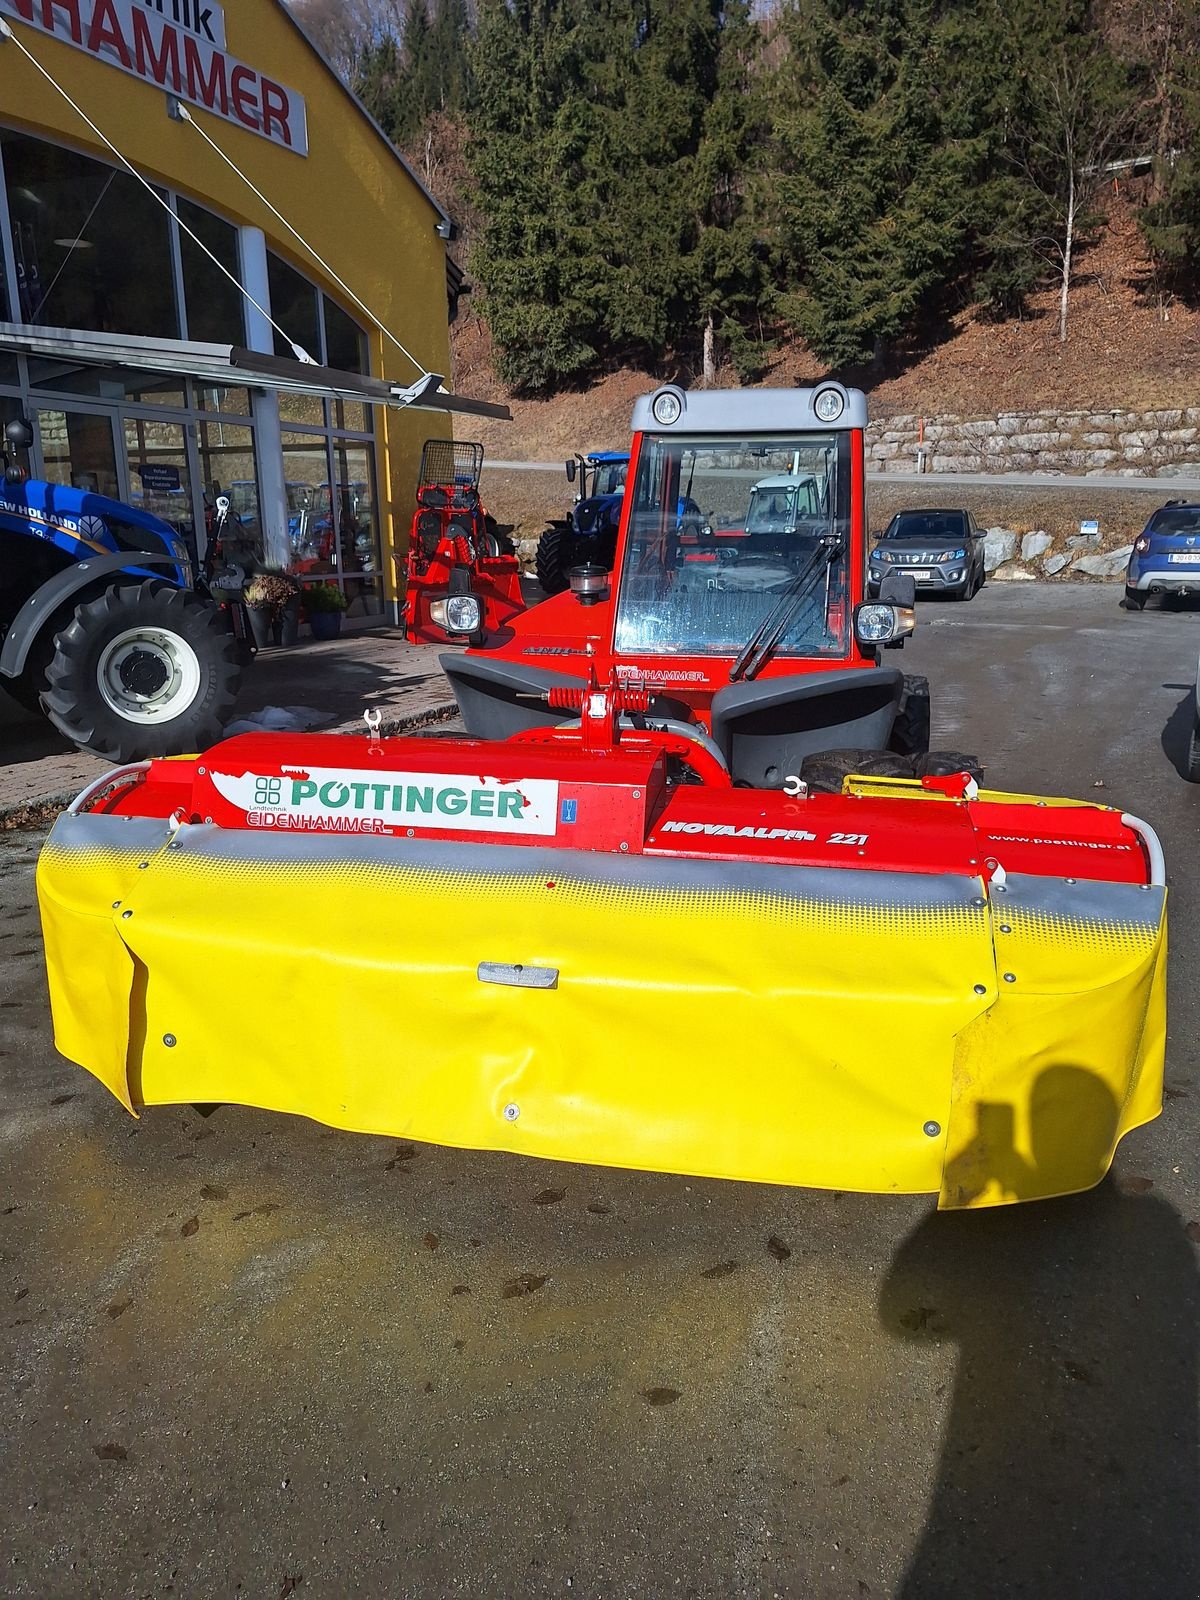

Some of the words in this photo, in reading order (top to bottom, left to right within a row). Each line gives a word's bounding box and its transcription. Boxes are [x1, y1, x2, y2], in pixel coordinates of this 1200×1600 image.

[18, 505, 77, 531] HOLLAND
[247, 811, 384, 833] EIDENHAMMER
[826, 833, 869, 845] 221
[988, 835, 1132, 850] www.poettinger.at
